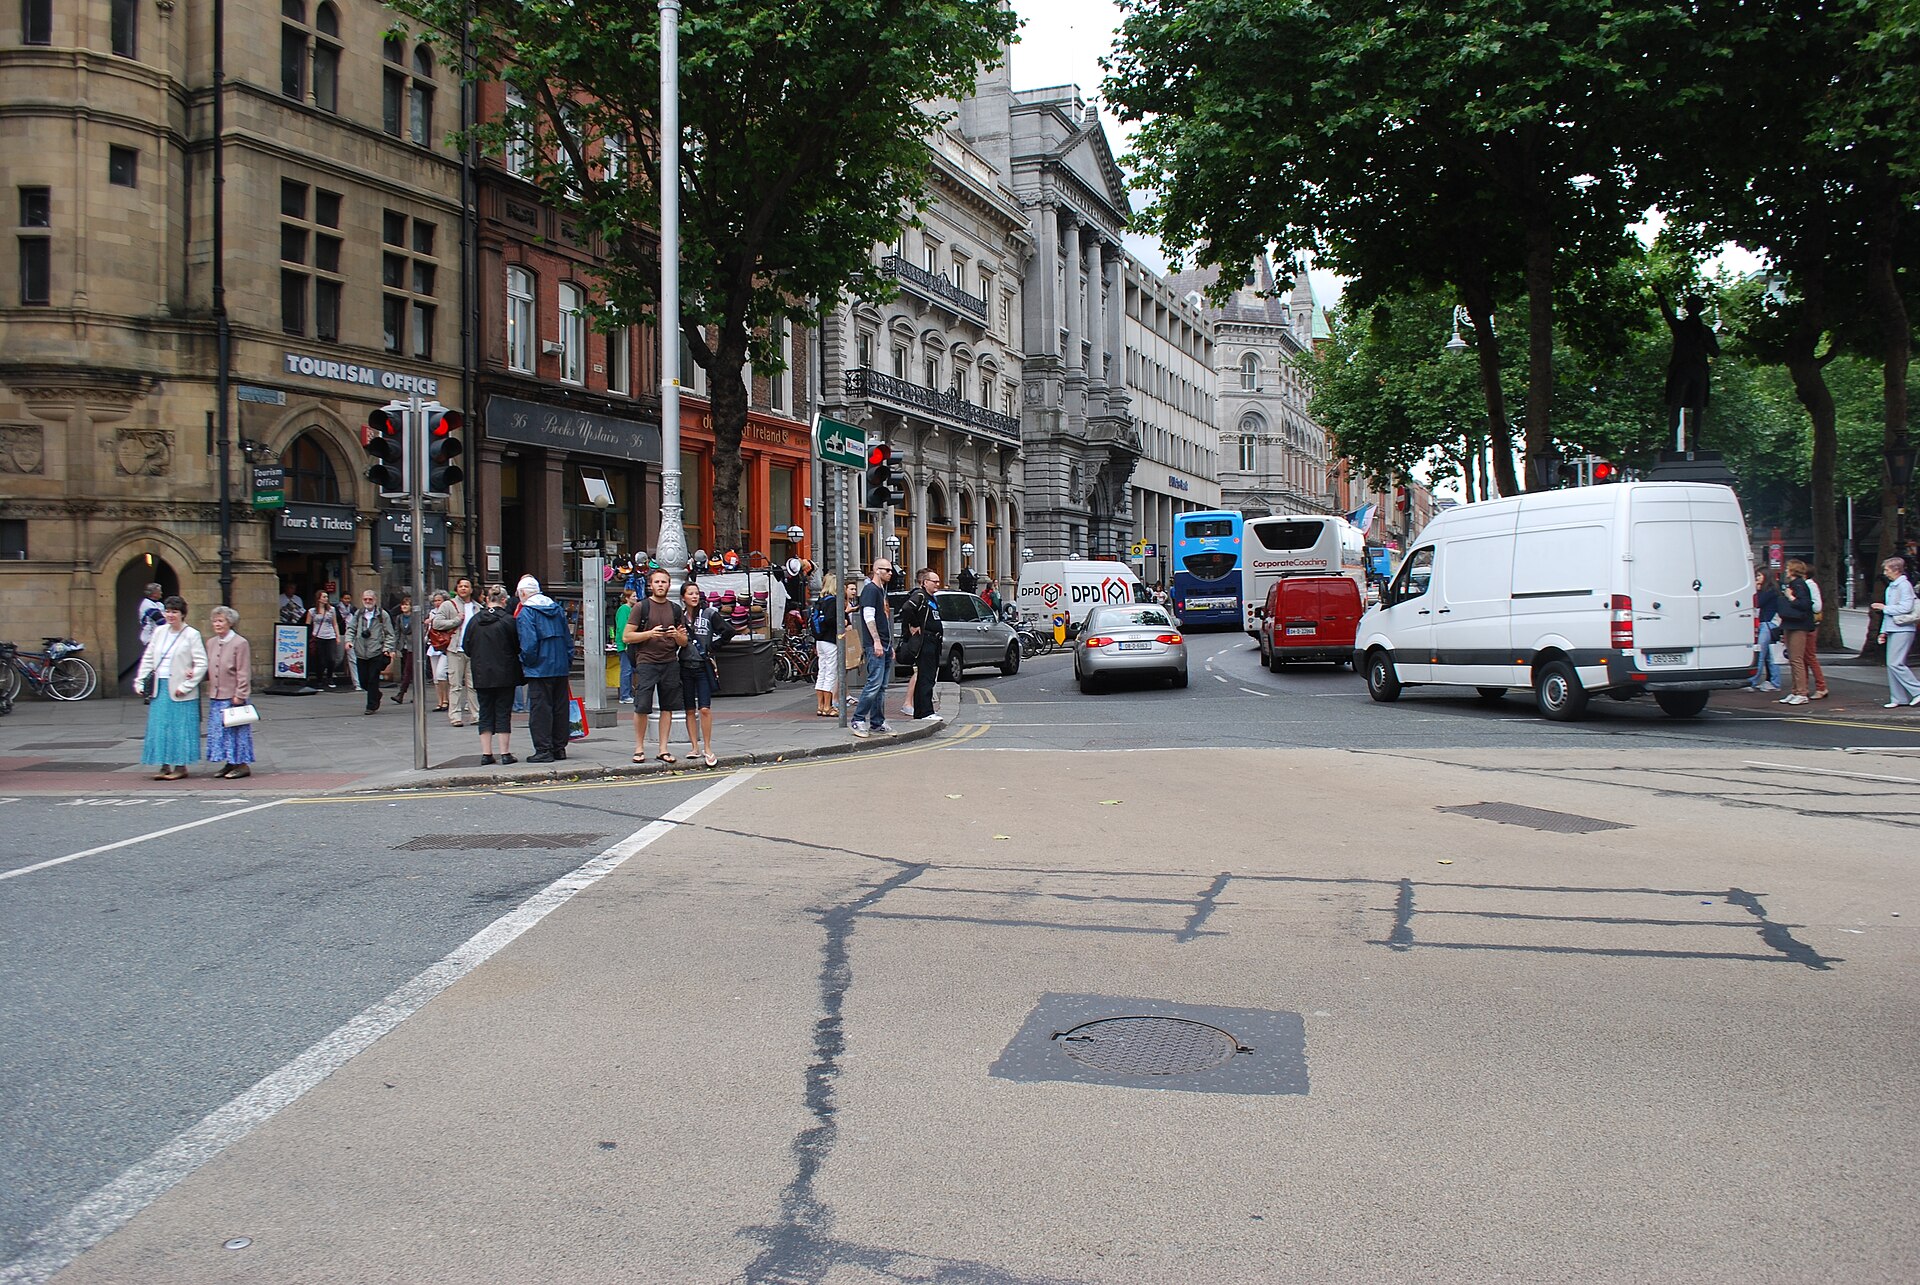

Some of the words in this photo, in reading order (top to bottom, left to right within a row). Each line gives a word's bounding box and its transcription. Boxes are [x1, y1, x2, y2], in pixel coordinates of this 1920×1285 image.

[287, 354, 374, 385] TOURISM
[381, 372, 436, 396] OFFICE
[510, 412, 528, 429] 36
[541, 412, 575, 437] Books
[576, 417, 619, 446] Upstairs
[630, 433, 644, 448] 36
[753, 423, 781, 443] Ireland
[253, 468, 282, 477] Tourism
[256, 478, 280, 487] Office
[281, 514, 308, 528] Tours
[309, 516, 318, 528] &
[321, 517, 353, 530] Tickets
[394, 523, 433, 534] Inforion
[1021, 587, 1041, 597] DPD
[1071, 585, 1101, 603] DPD
[55, 798, 178, 806] LOOK
